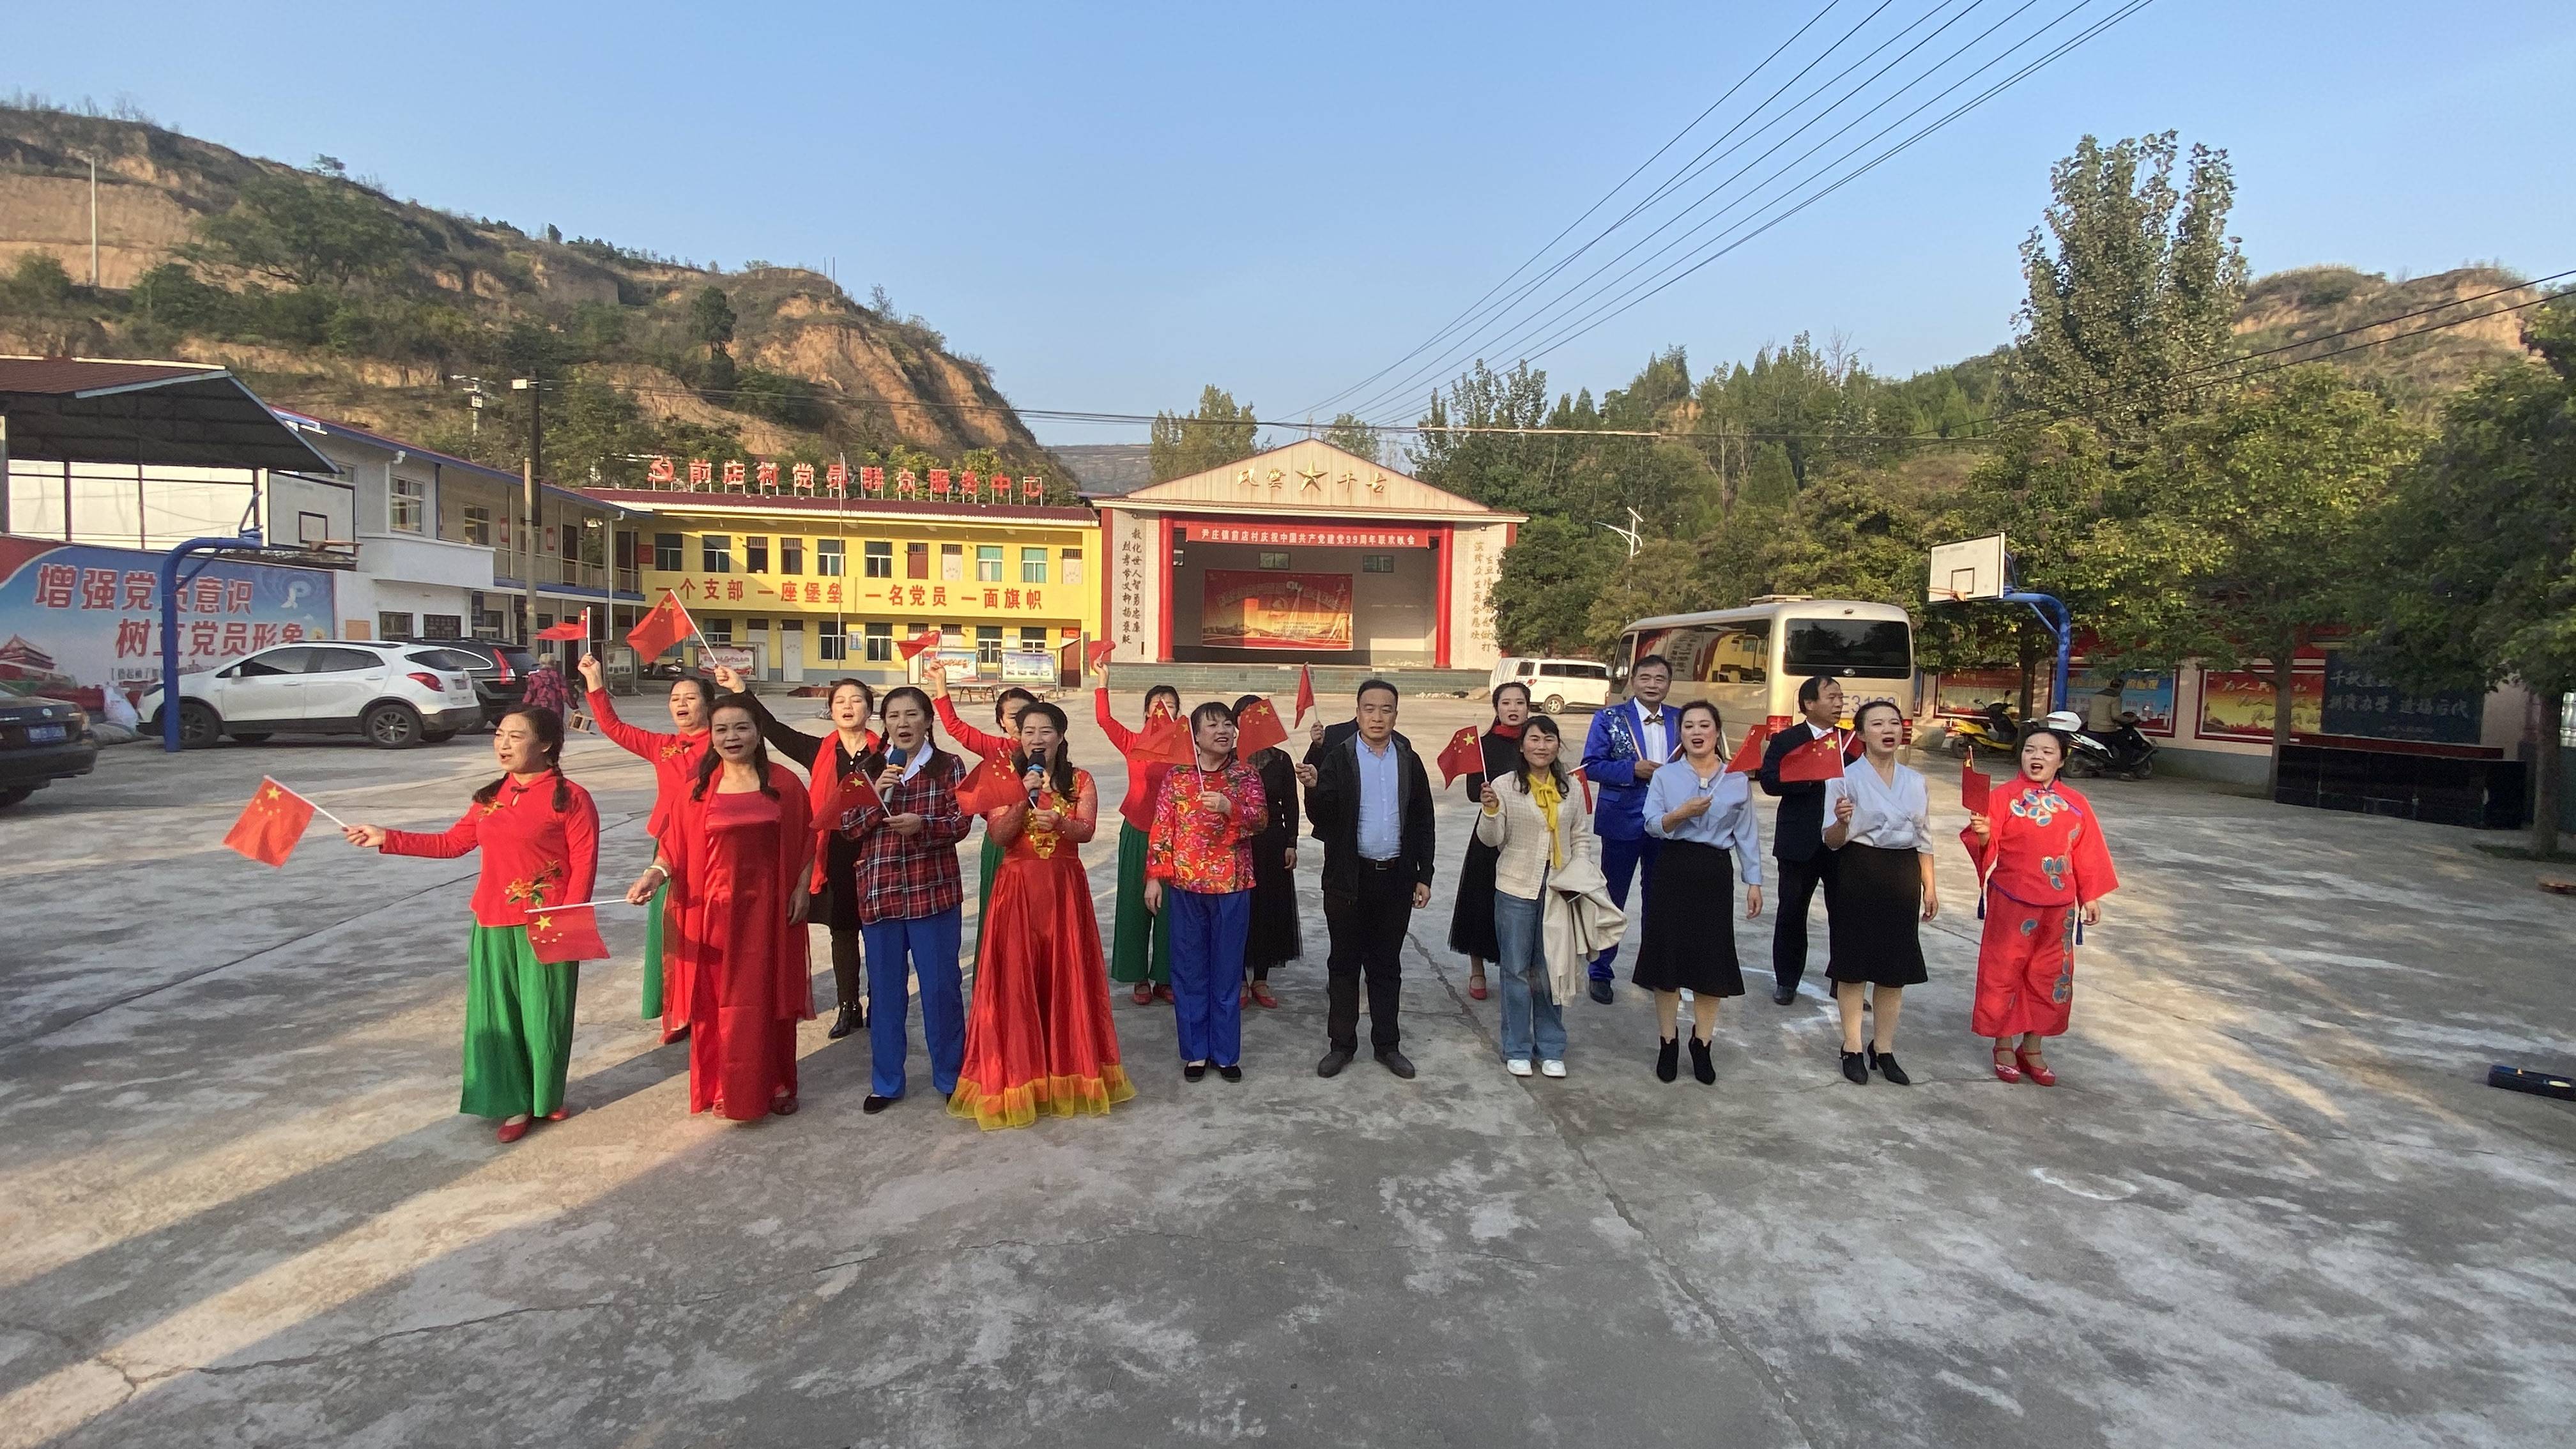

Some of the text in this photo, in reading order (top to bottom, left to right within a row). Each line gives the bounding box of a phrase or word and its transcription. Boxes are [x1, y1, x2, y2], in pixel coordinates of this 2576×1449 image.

[656, 578, 1043, 610] 一个支部 一座堡垒 一名党员 一面旗帜
